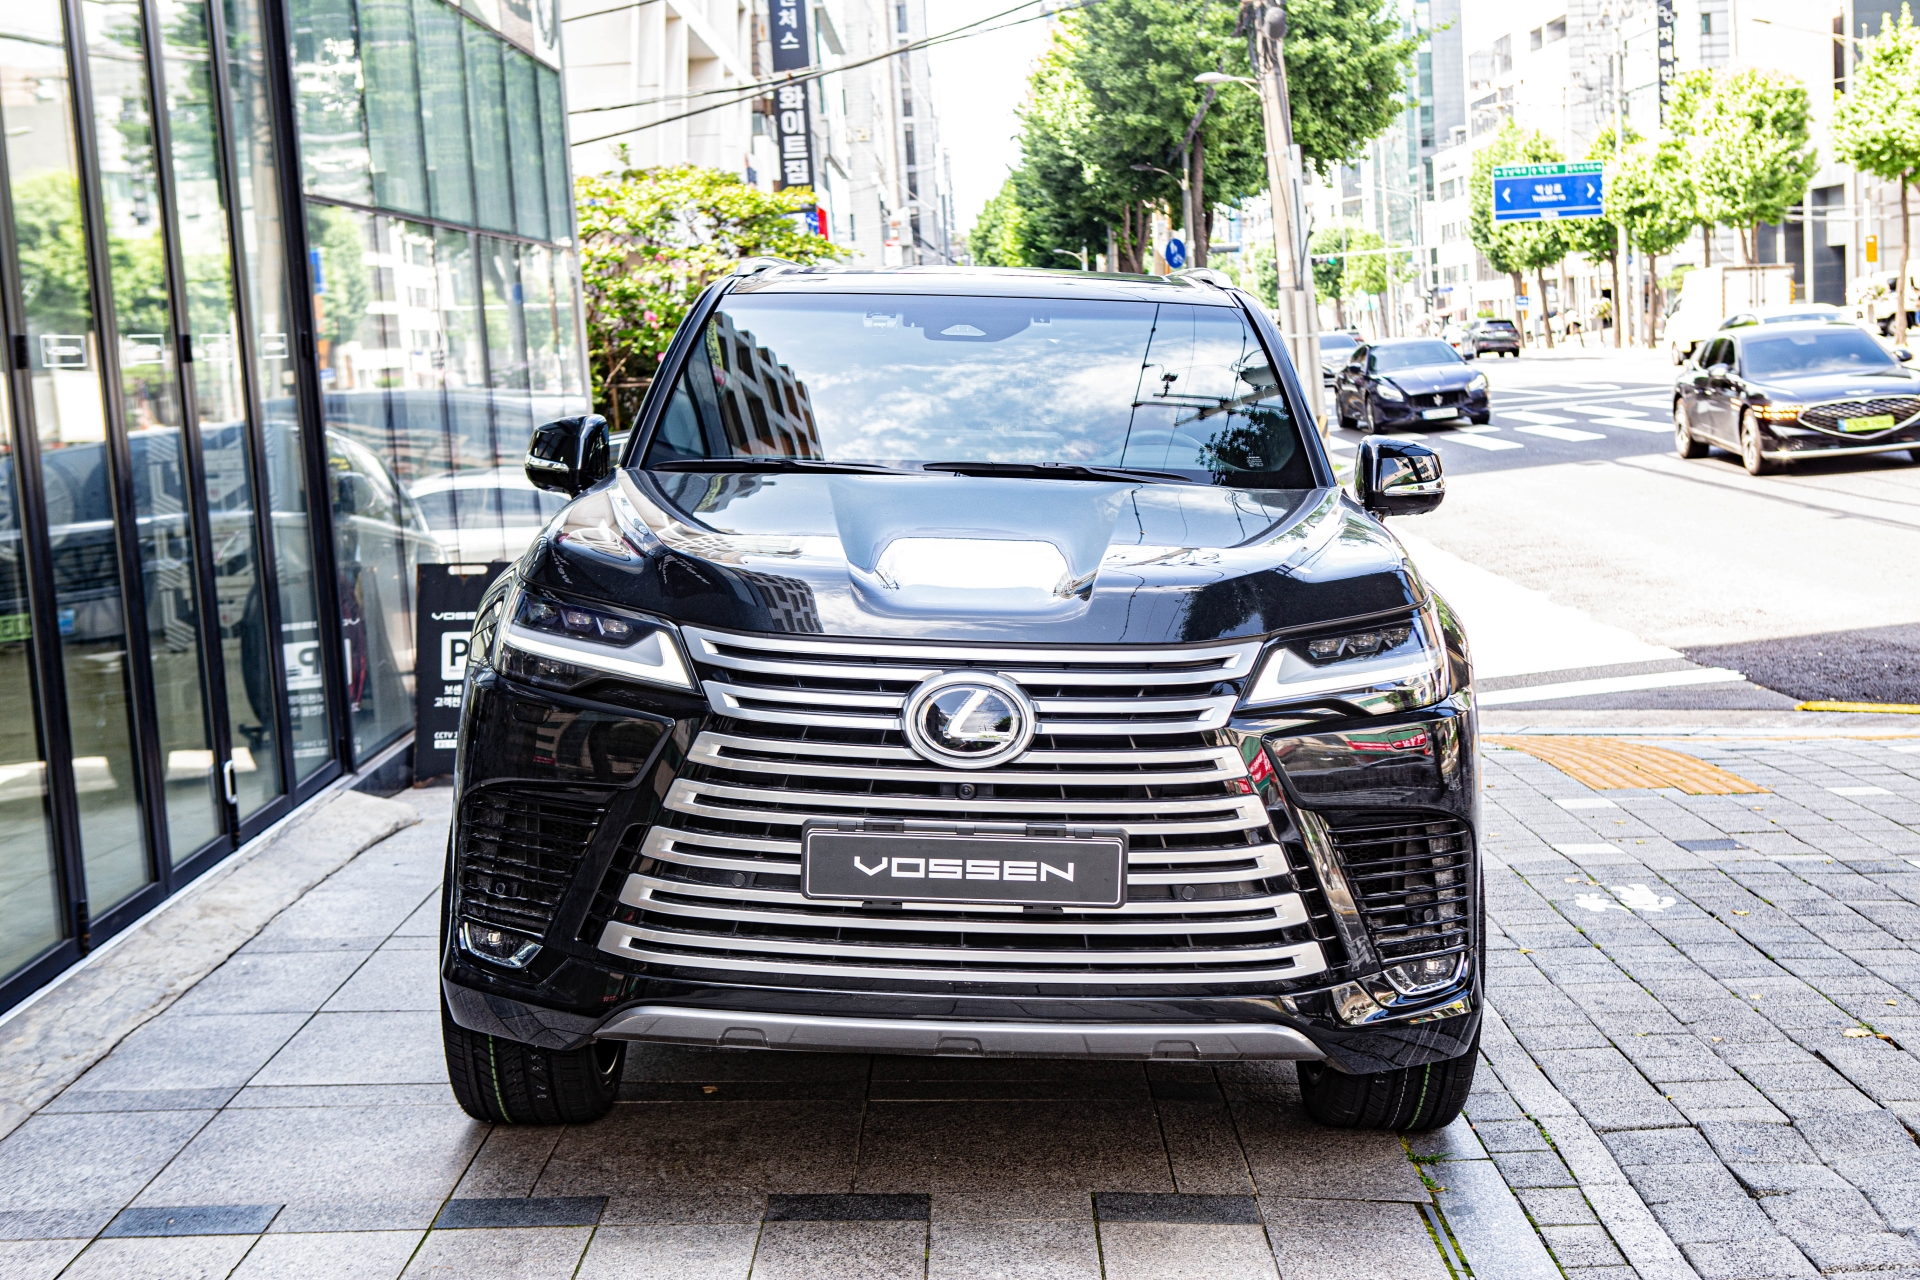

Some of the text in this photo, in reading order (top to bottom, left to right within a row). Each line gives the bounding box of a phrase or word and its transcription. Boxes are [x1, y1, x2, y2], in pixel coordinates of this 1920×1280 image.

[779, 85, 810, 185] 화이트짐
[450, 638, 470, 667] P
[434, 731, 453, 740] CCTV
[853, 855, 1075, 883] VOSSEN
